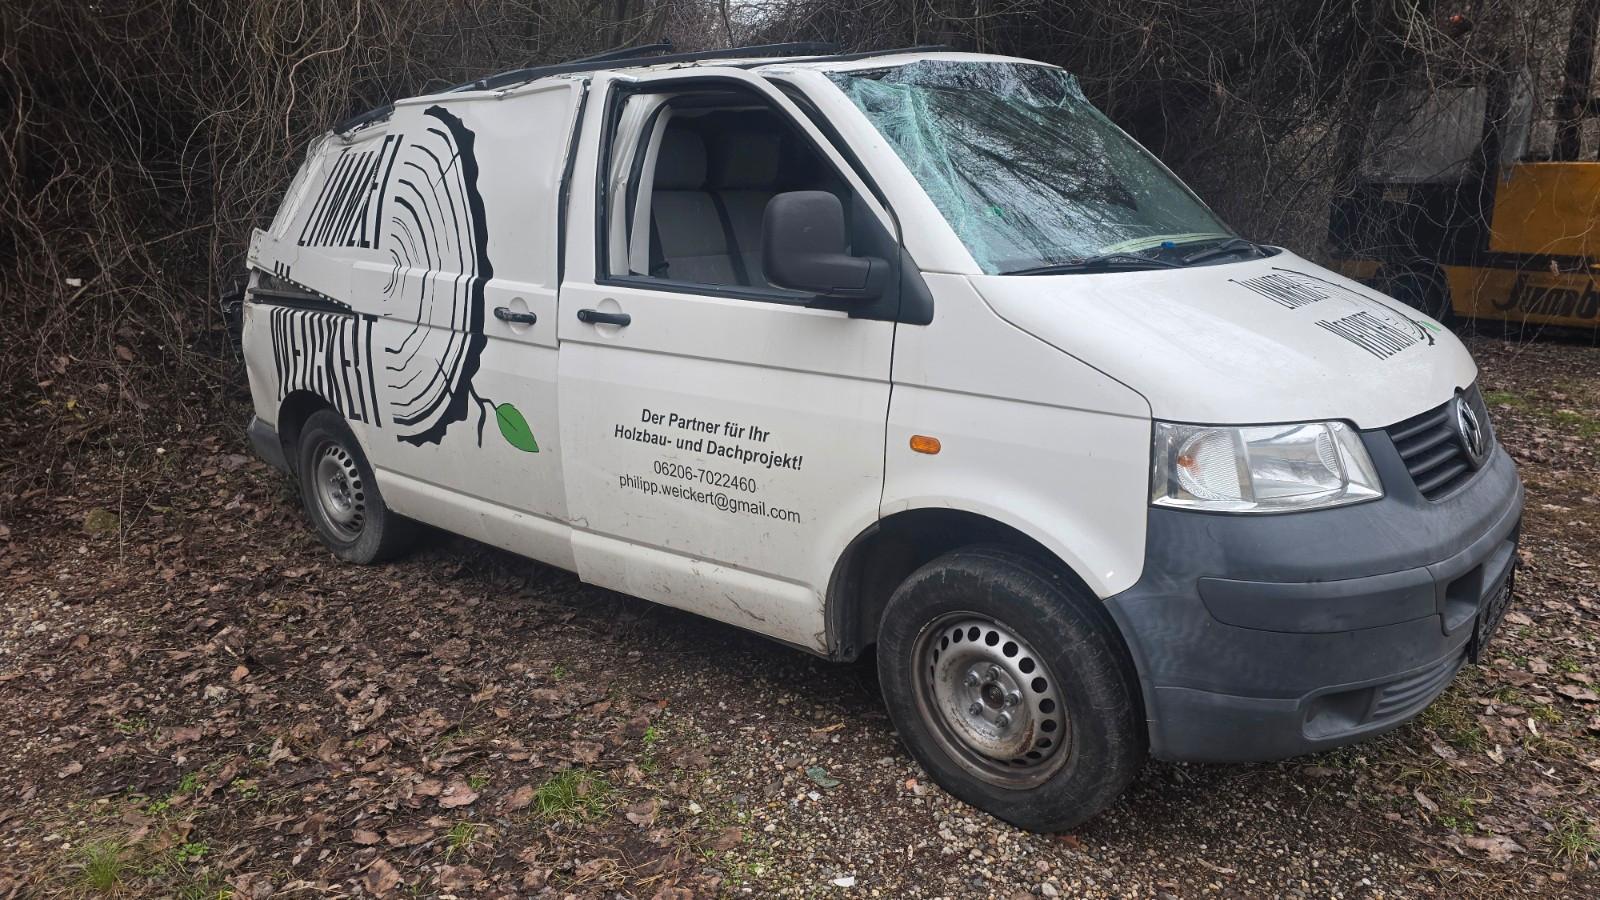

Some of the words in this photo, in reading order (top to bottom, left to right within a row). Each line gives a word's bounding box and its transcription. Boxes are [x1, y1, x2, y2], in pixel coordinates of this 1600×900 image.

[641, 408, 666, 425] Der
[668, 412, 721, 435] Partner
[723, 421, 746, 439] für
[749, 425, 771, 443] Ihr
[614, 424, 672, 446] Holzbau-
[676, 436, 702, 452] und
[707, 440, 804, 470] Dachprojekt!
[653, 460, 757, 493] 06206-7022460
[619, 473, 801, 524] philipp.weickert@gmail.com
